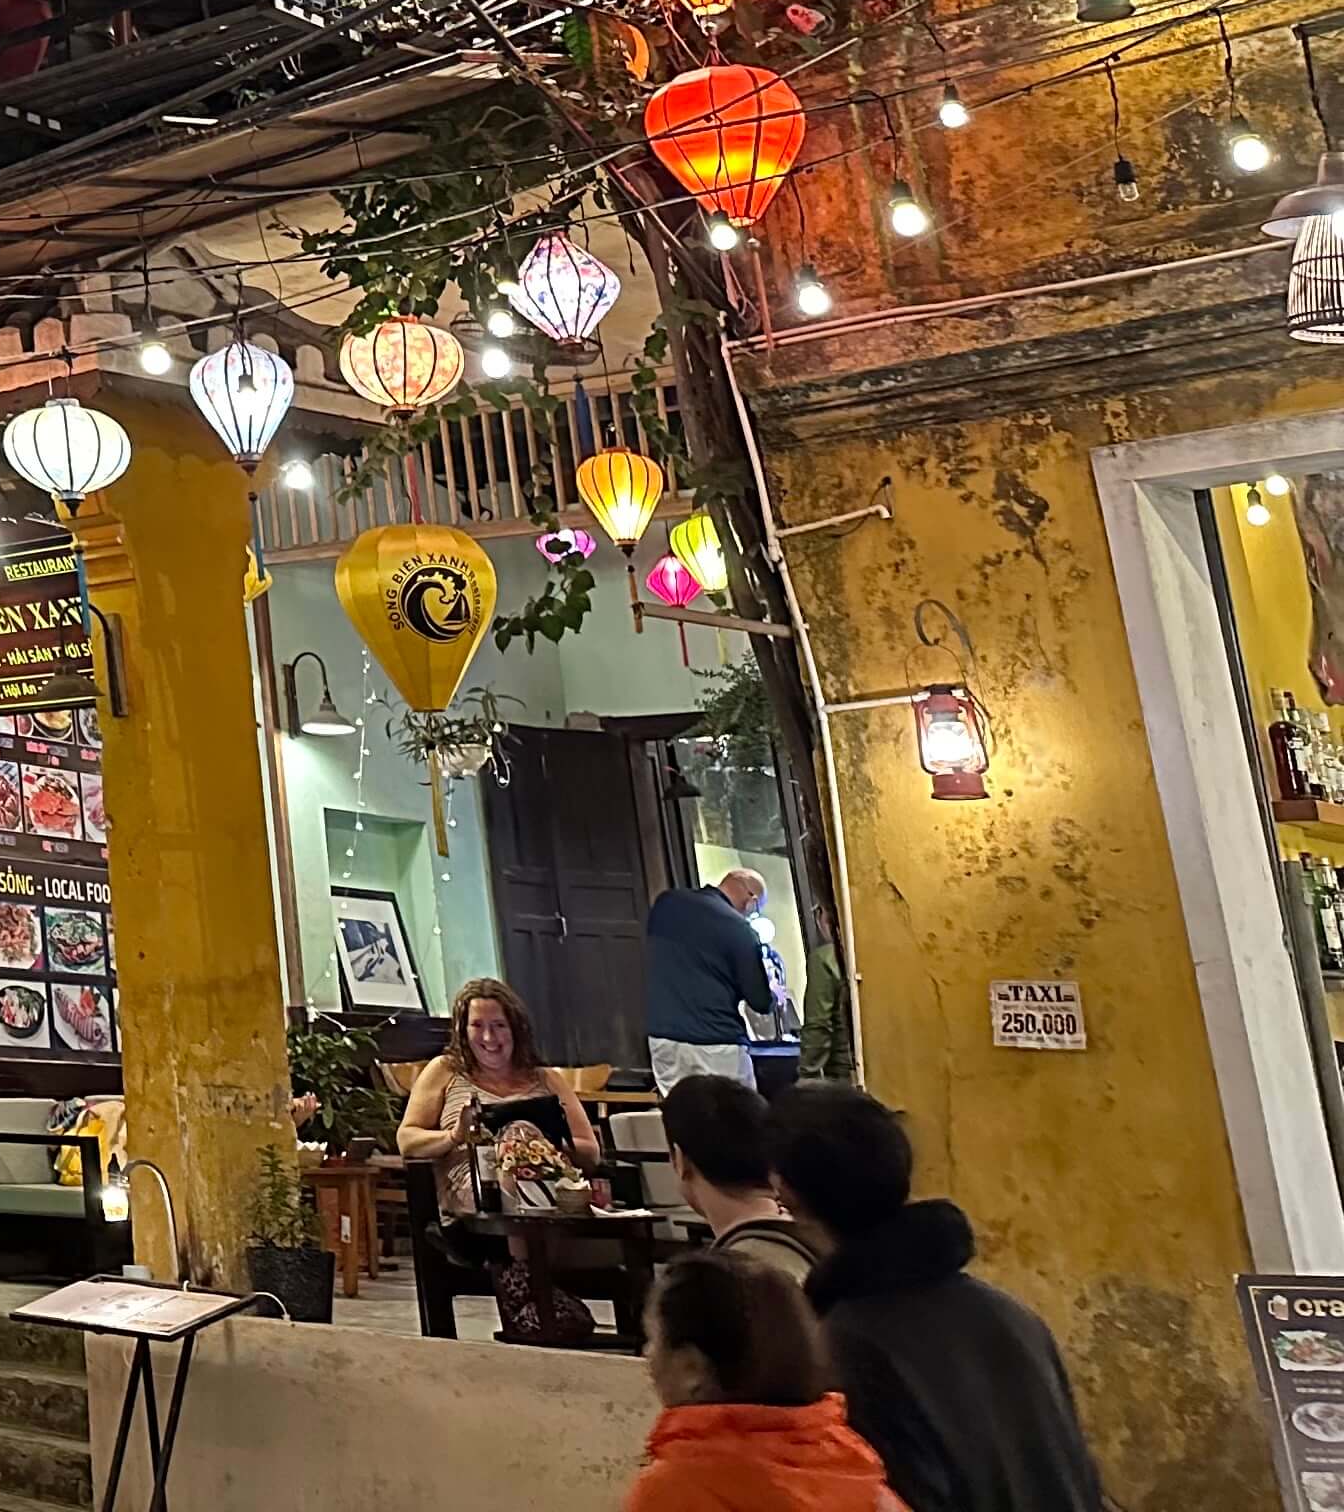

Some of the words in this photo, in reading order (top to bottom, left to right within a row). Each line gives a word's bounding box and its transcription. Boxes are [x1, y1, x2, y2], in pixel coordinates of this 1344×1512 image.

[4, 555, 78, 579] RESTAURANT
[427, 552, 469, 570] XANH
[26, 596, 82, 630] XAN
[20, 682, 37, 696] An
[44, 877, 85, 901] LOCAL
[1008, 985, 1062, 1002] TAXI
[1002, 1012, 1077, 1035] 250.000
